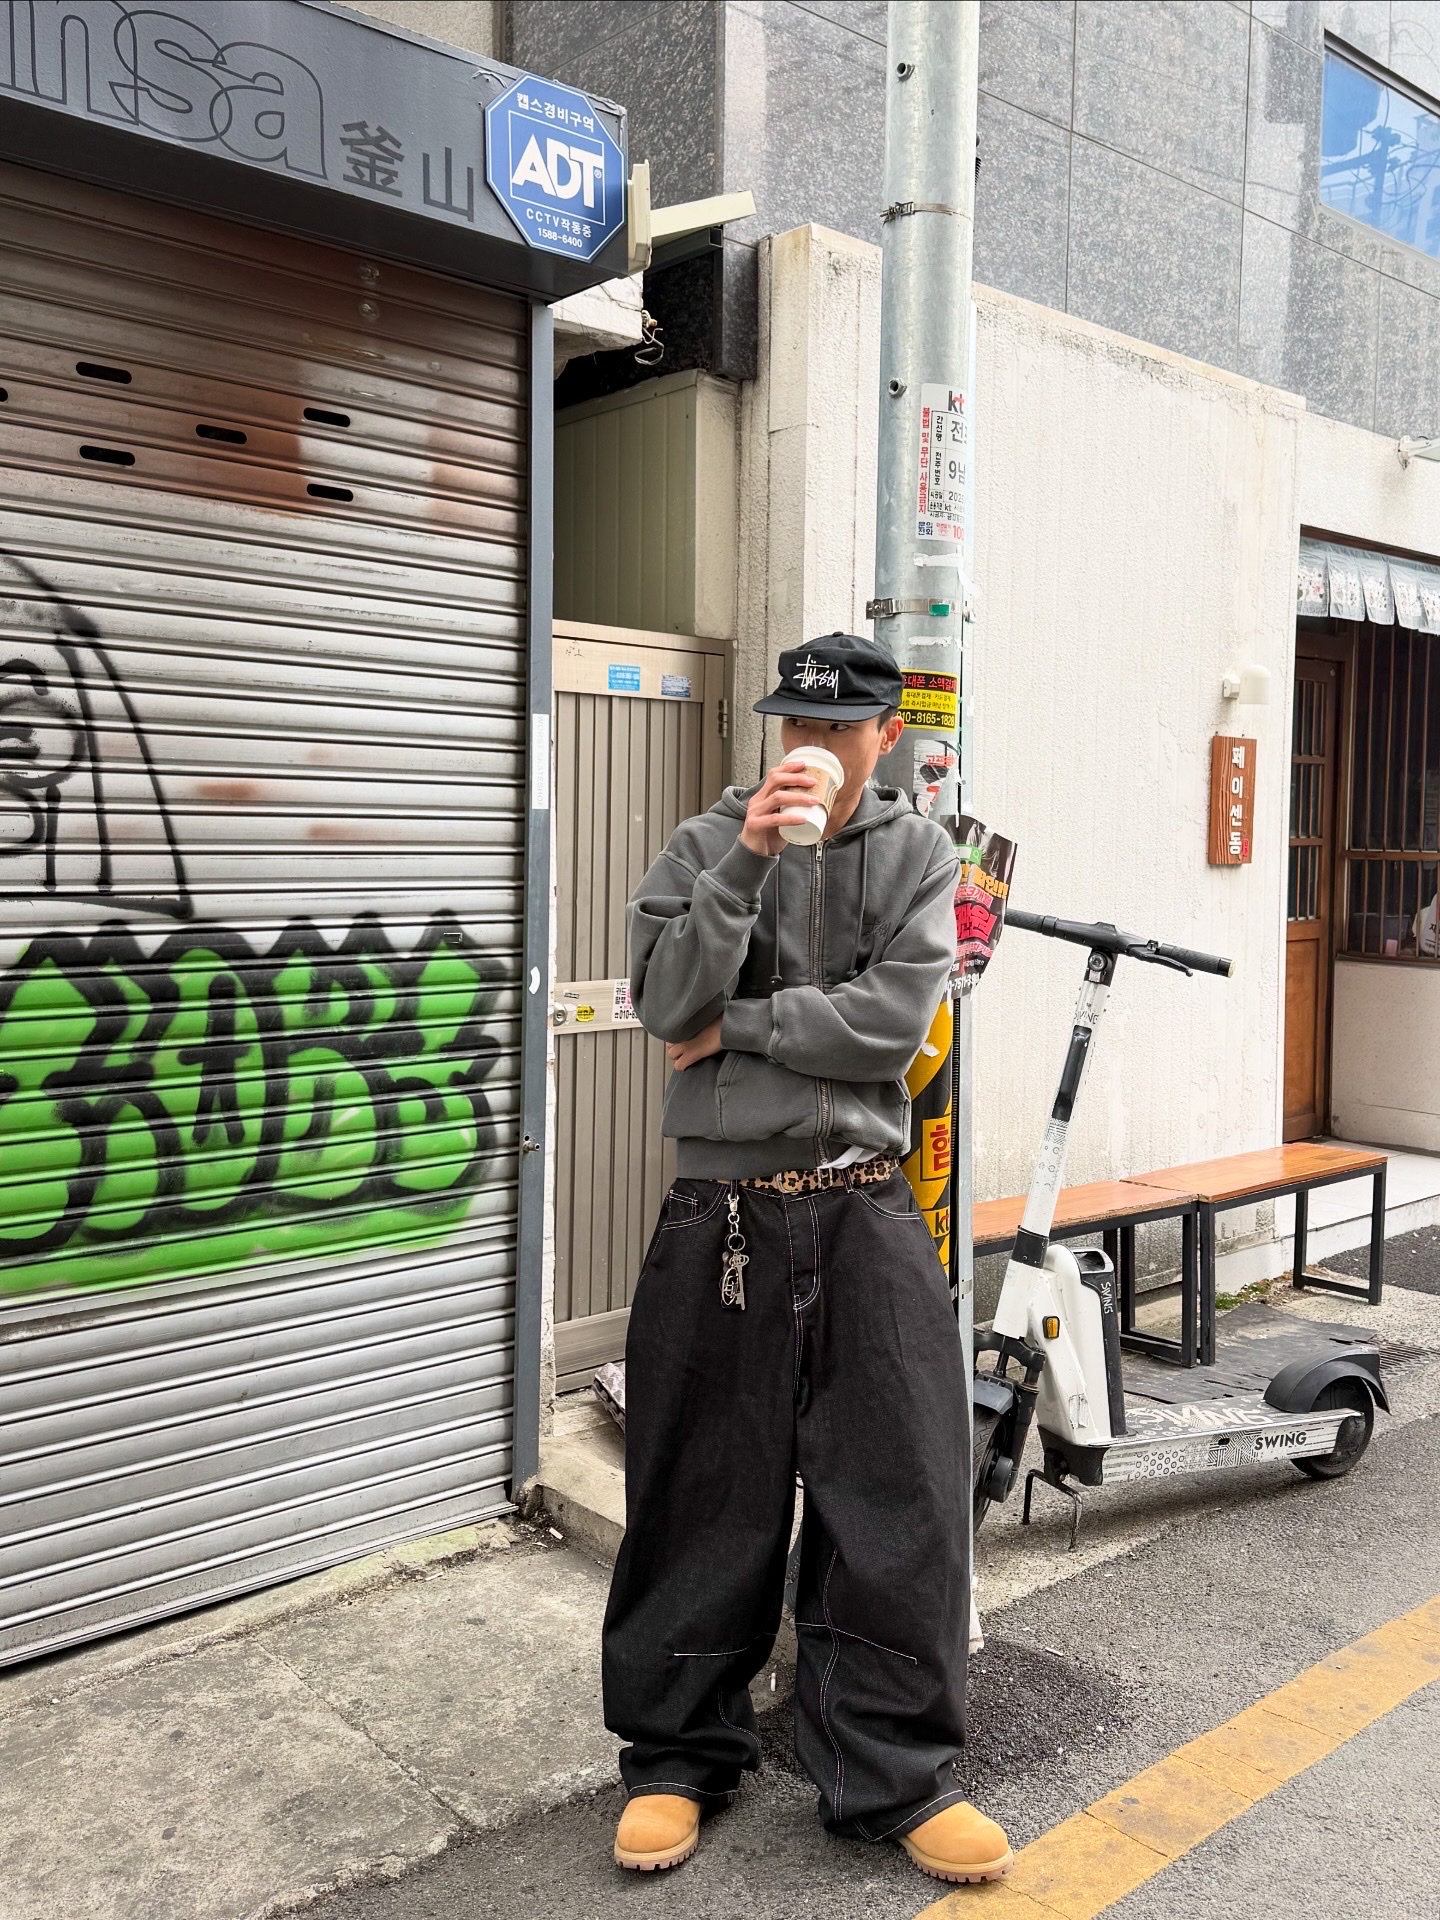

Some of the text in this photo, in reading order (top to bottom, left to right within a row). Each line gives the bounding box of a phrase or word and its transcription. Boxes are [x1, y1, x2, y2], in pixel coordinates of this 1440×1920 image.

[517, 92, 594, 132] 캡스경비구역
[338, 119, 475, 222] 釜山
[511, 133, 603, 208] ADT
[537, 226, 583, 248] 1588-6400
[1229, 746, 1245, 856] 페이센동
[1254, 1431, 1307, 1451] SWING
